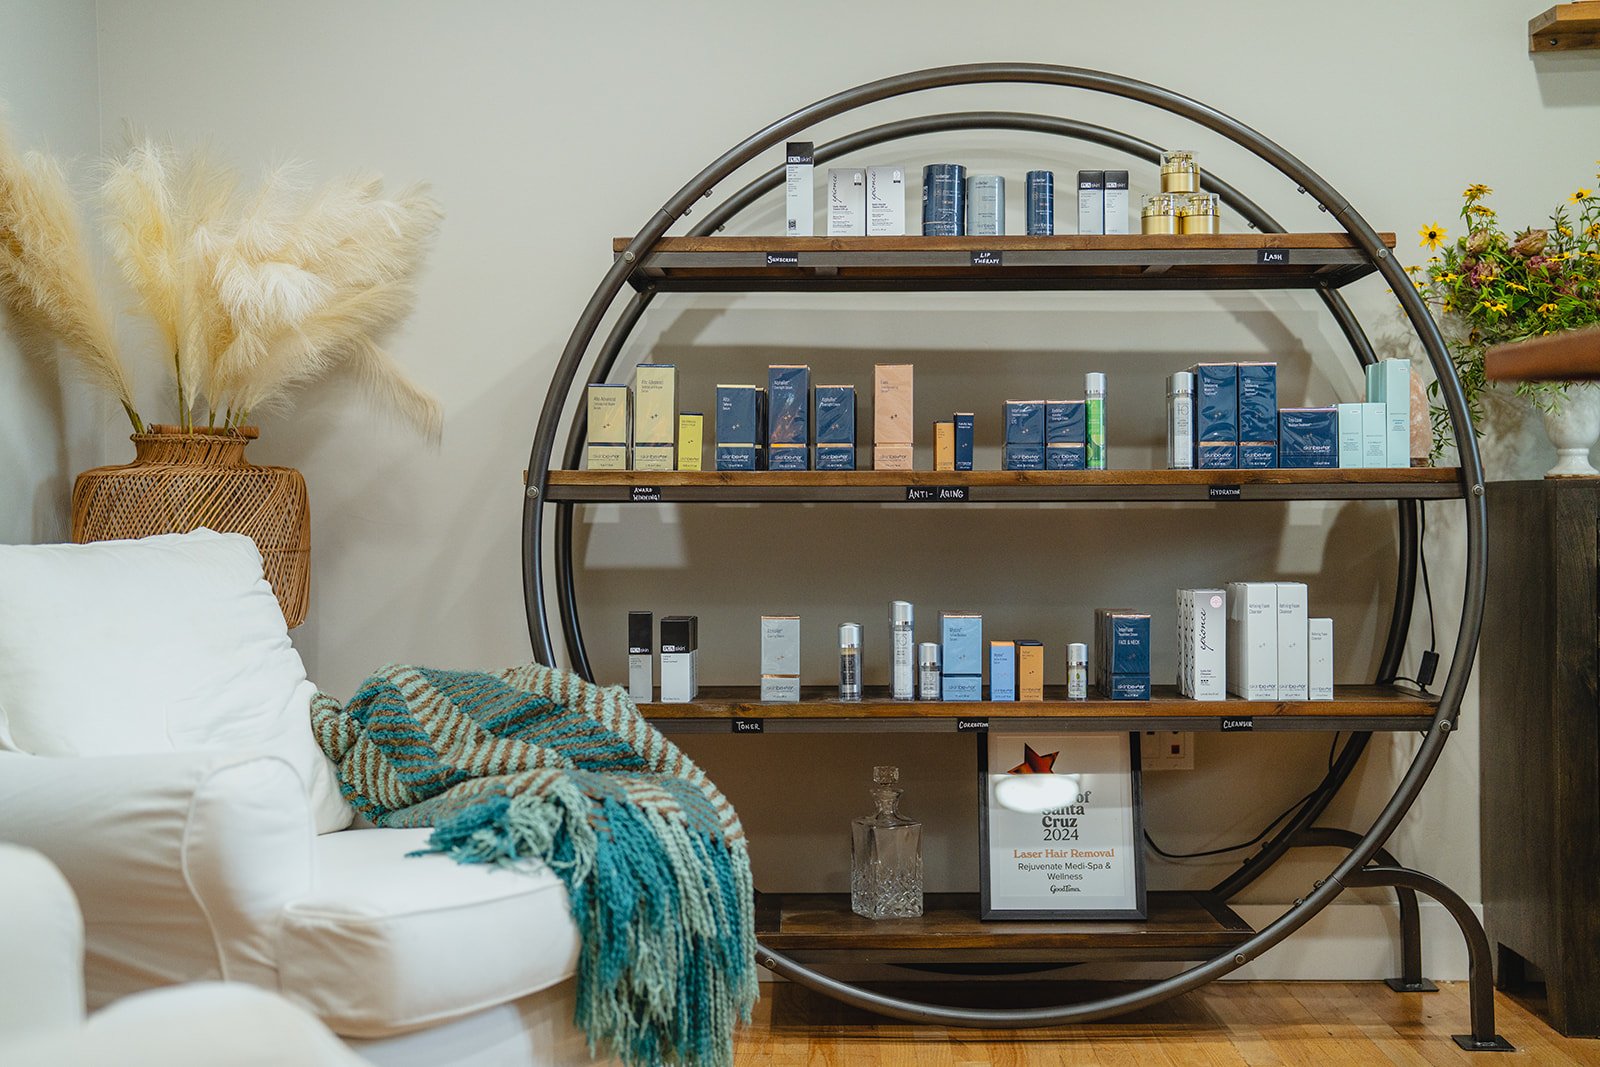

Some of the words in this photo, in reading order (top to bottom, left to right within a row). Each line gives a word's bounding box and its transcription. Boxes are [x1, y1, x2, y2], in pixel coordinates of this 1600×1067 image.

[1264, 252, 1283, 261] LASH
[940, 489, 964, 499] AGING
[736, 721, 760, 731] TONER
[1076, 791, 1092, 803] of
[1041, 815, 1078, 828] Cruz
[1043, 828, 1079, 841] 2024
[1013, 849, 1043, 859] Laser
[1045, 849, 1068, 858] Hair
[1071, 848, 1115, 858] Removal
[1018, 862, 1063, 872] Rejuvenate
[1065, 862, 1103, 872] Medi-Spa
[1047, 872, 1083, 881] Wellness
